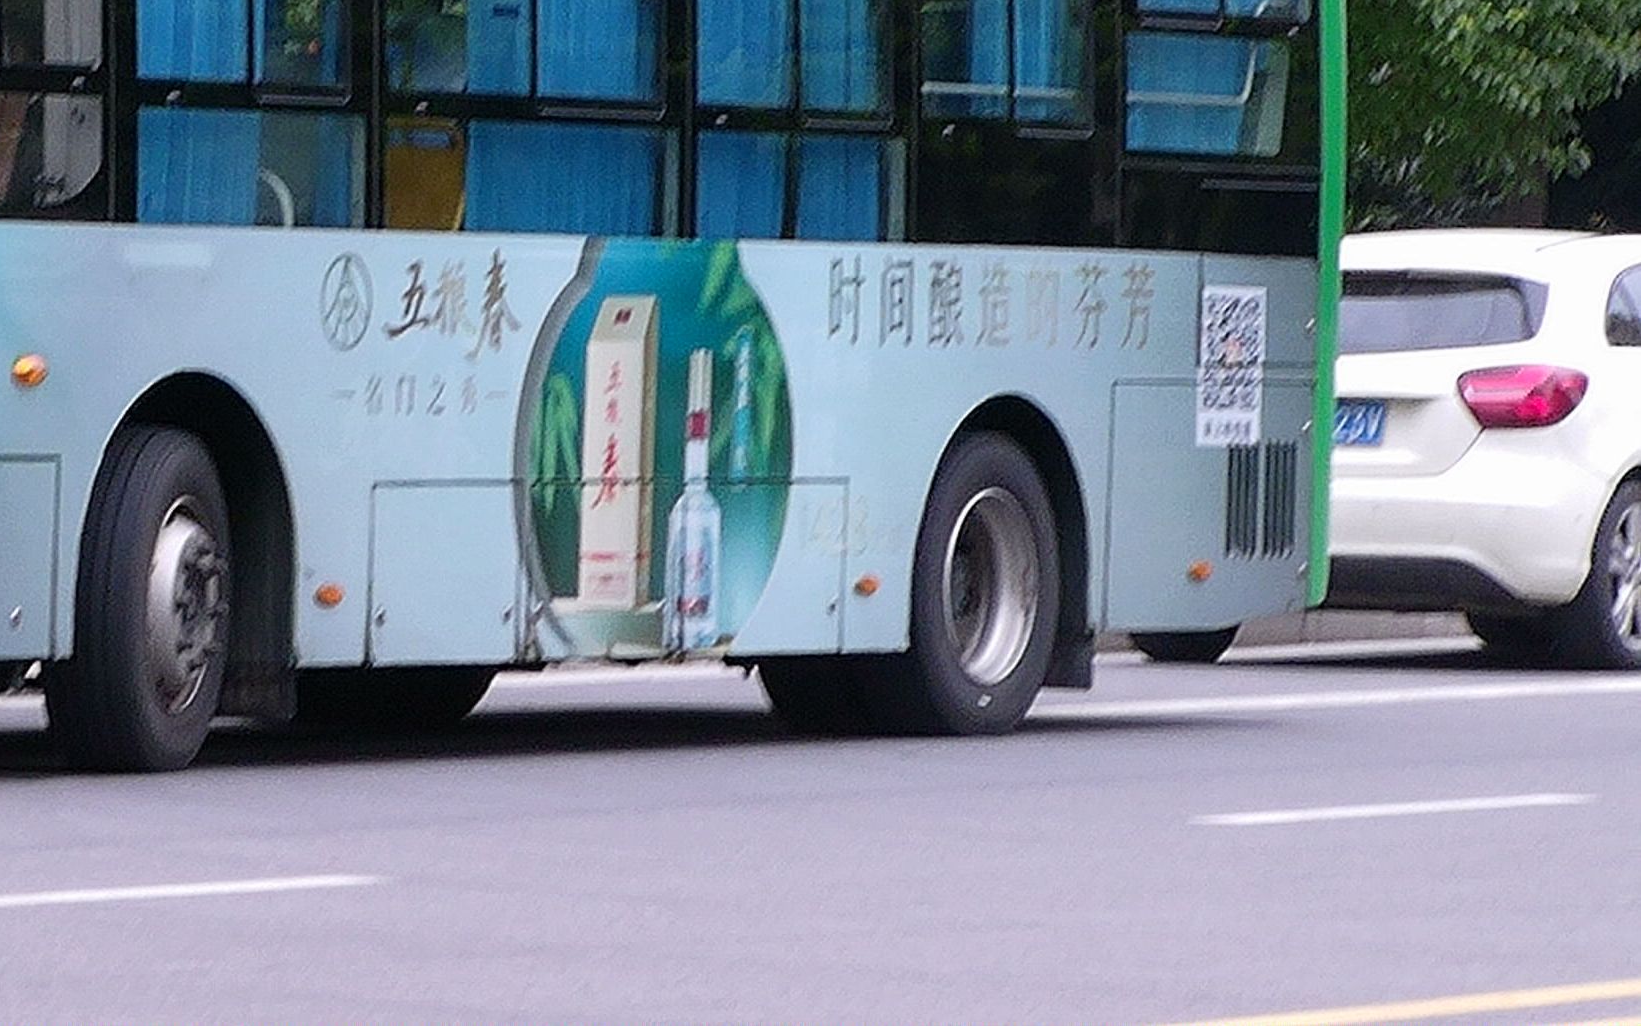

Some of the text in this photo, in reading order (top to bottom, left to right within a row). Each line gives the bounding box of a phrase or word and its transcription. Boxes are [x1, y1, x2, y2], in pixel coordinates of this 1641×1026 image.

[827, 252, 1157, 349] 时间酿造的芬芳
